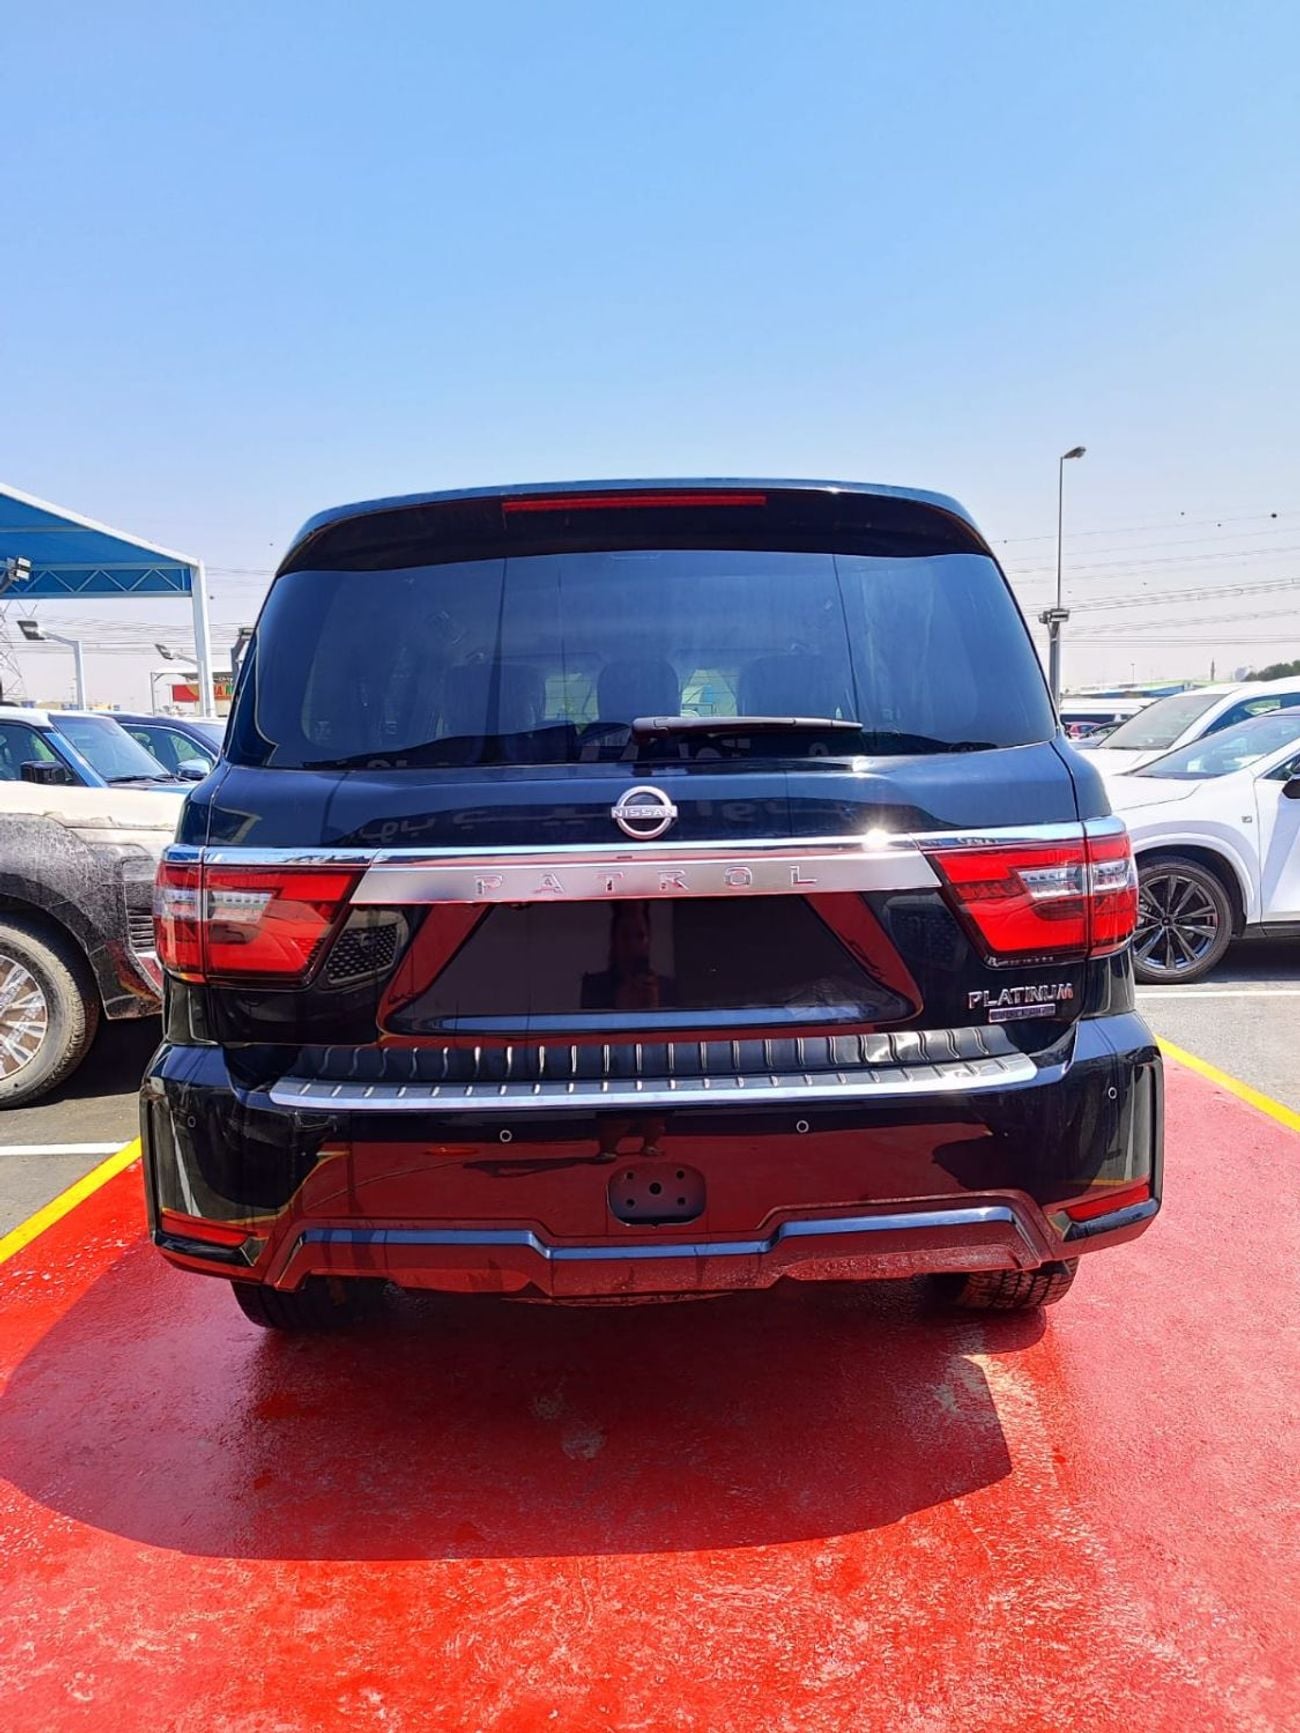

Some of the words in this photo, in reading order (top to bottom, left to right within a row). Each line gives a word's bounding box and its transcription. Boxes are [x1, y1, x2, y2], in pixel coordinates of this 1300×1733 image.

[612, 807, 676, 818] NISSAN
[474, 866, 817, 895] PATROL
[968, 983, 1073, 1009] PLATINUM
